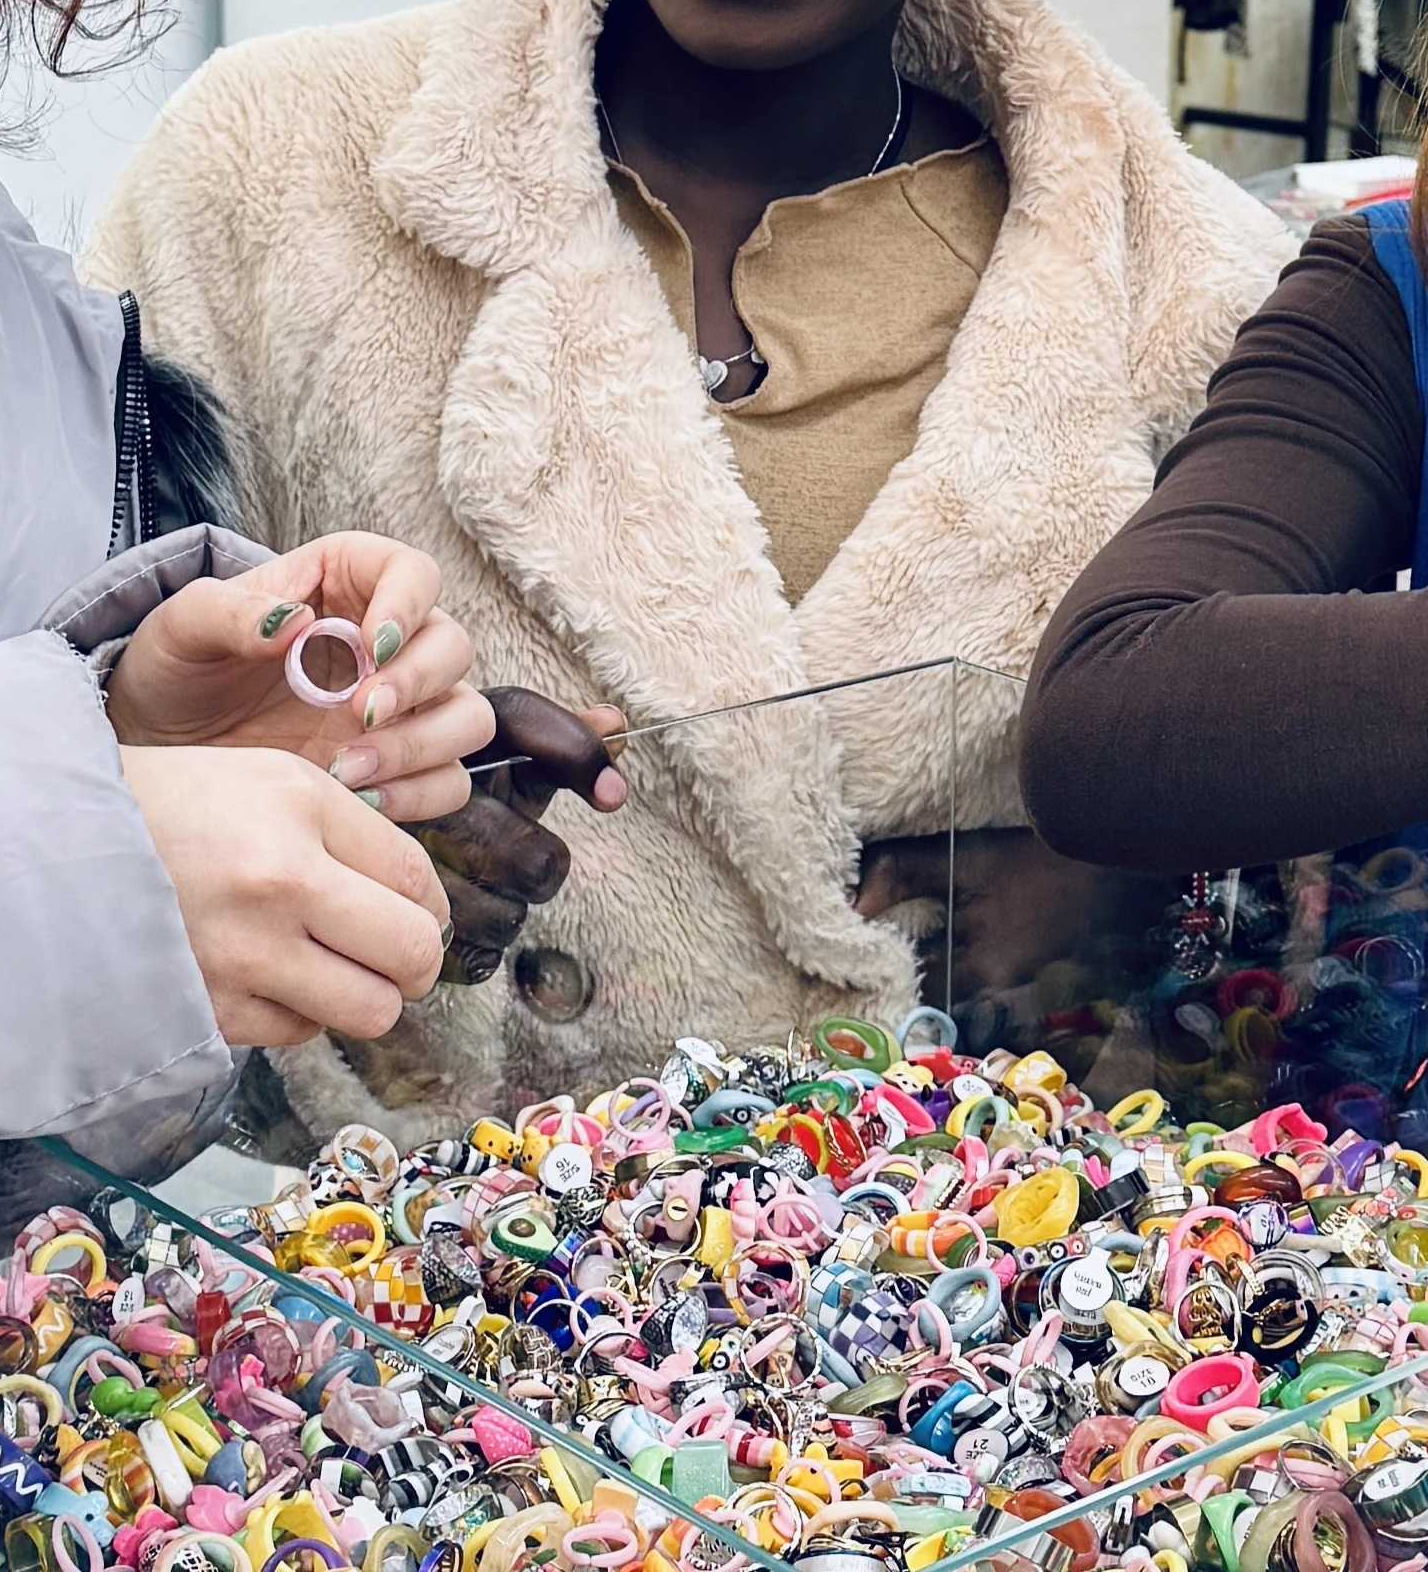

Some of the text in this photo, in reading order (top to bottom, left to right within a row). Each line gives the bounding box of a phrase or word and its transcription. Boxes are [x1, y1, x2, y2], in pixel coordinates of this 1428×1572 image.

[556, 1157, 571, 1172] 16
[559, 1164, 580, 1183] SIZE
[1130, 1367, 1155, 1383] SIZE
[973, 1438, 989, 1450] 21
